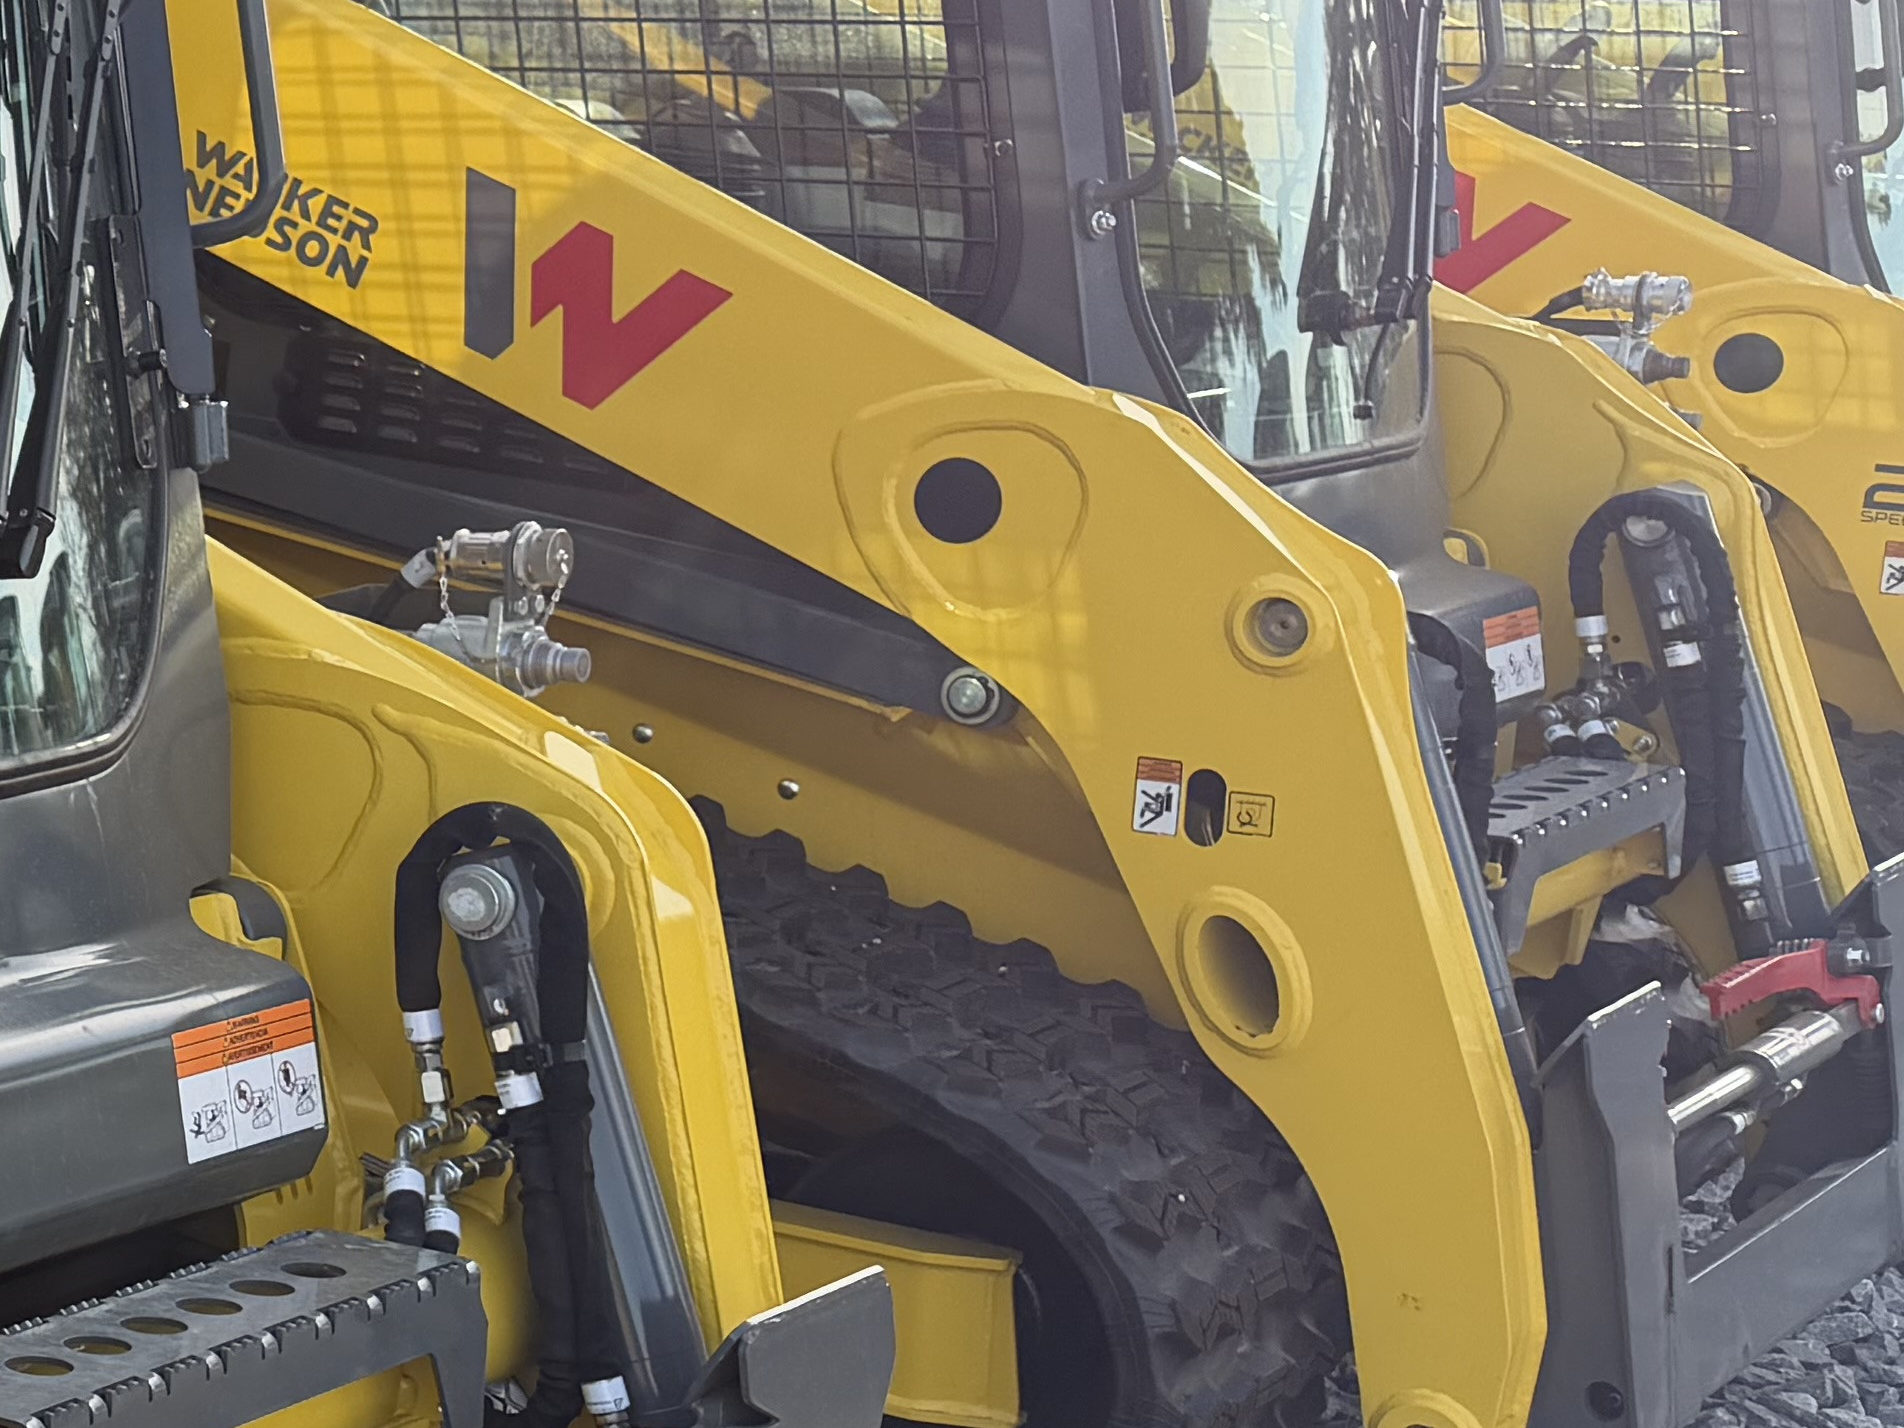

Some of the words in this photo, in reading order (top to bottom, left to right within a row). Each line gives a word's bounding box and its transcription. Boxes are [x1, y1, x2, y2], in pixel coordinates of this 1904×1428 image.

[185, 167, 369, 290] NESON
[196, 129, 379, 253] WAKER
[1861, 510, 1904, 525] SPE
